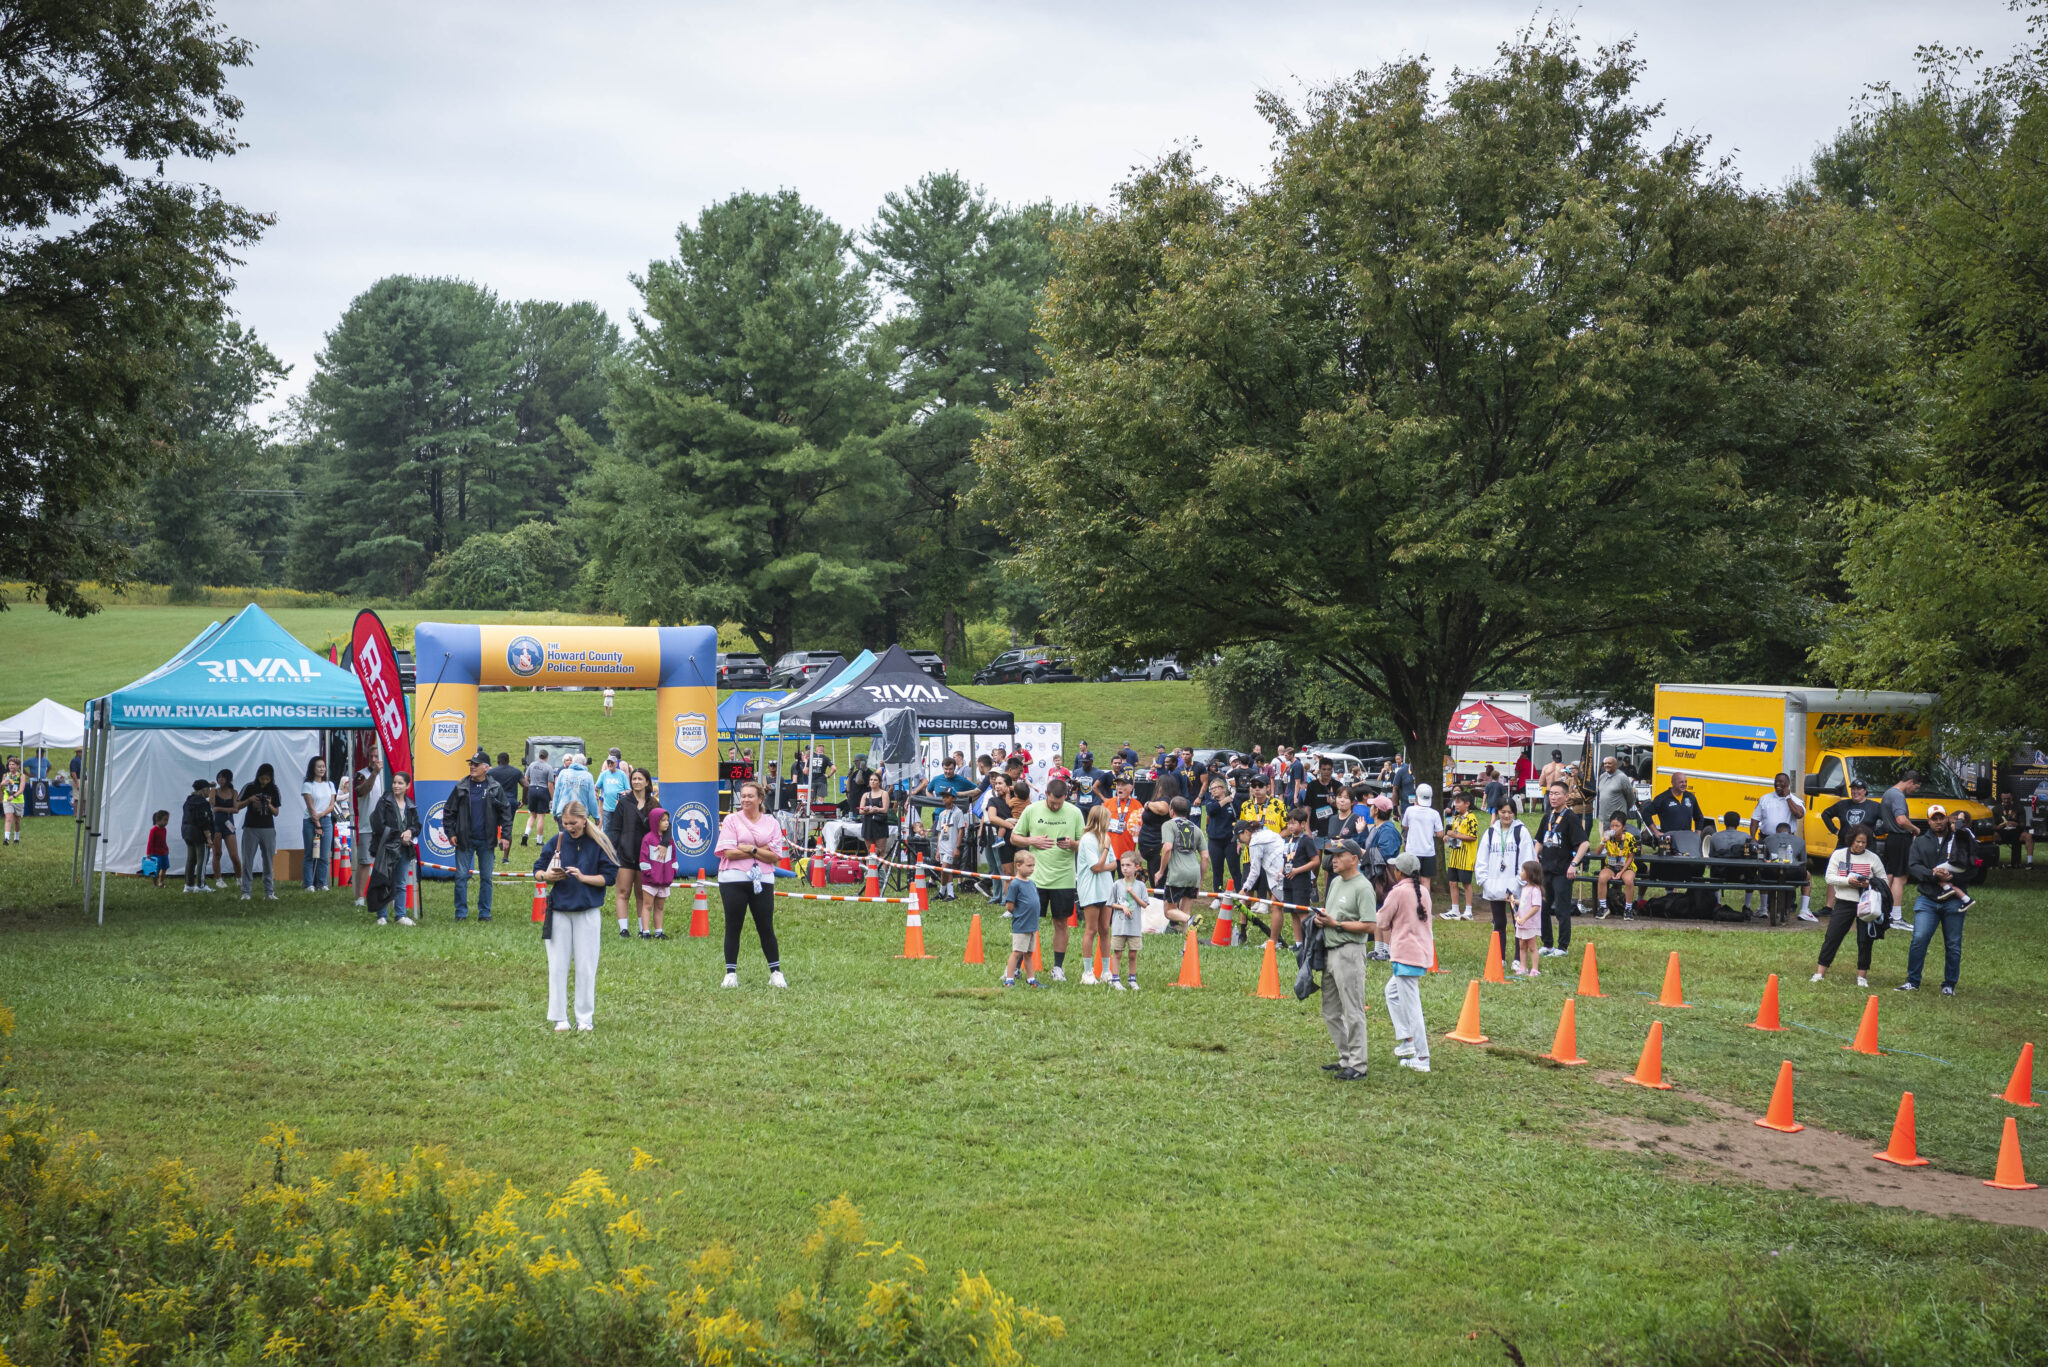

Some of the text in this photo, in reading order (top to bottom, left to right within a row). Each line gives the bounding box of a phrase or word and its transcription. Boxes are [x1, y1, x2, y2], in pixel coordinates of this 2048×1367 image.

[547, 642, 560, 650] THE
[547, 650, 623, 663] Howard County
[196, 658, 322, 678] RIVAL
[547, 663, 635, 674] Police Foundation
[861, 684, 949, 699] RIVAL
[123, 705, 372, 718] WWW.RIVALRACINGSERIES.C
[1671, 726, 1701, 739] PENSKE
[1755, 728, 1767, 737] Local
[1752, 741, 1769, 751] One Way
[1674, 750, 1698, 759] Truck Rental
